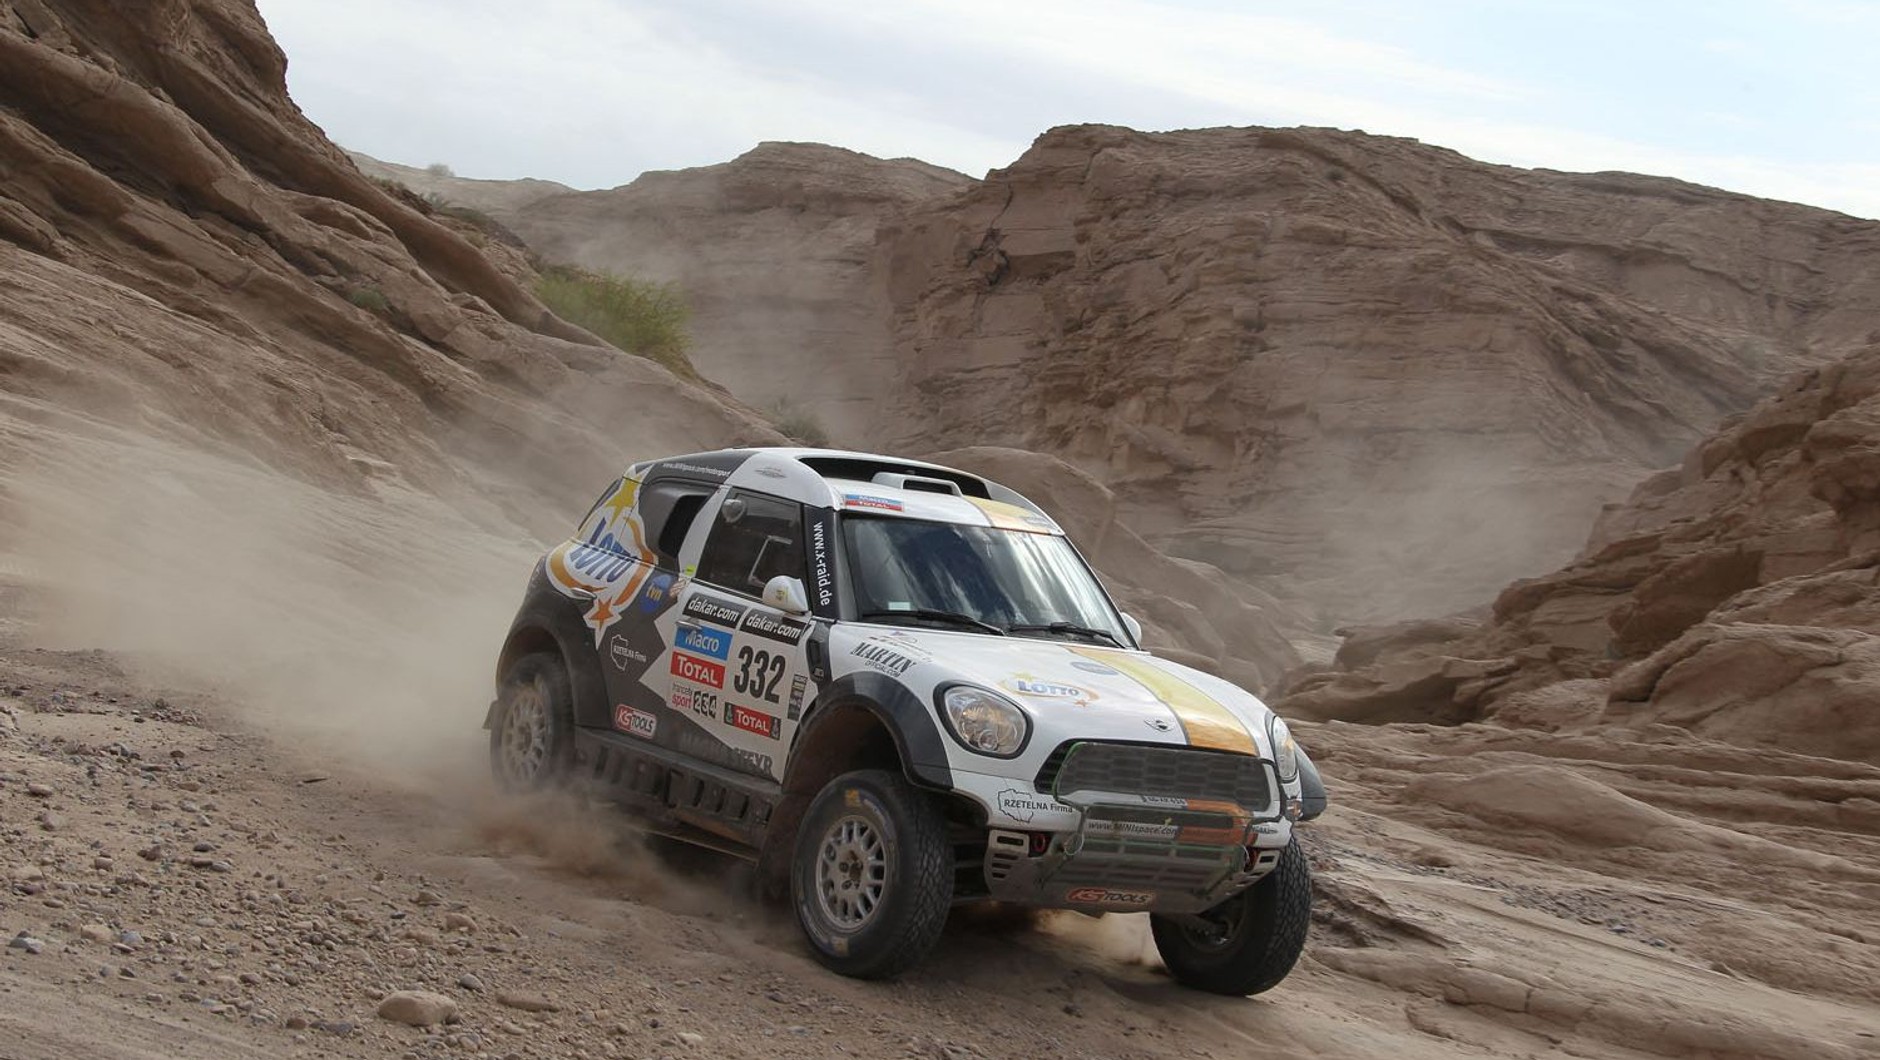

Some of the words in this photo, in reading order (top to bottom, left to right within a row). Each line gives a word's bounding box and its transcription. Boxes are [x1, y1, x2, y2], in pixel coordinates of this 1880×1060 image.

[813, 521, 833, 606] www.x-raid.de
[687, 597, 740, 622] dakar.com
[745, 614, 802, 639] dakar.com
[685, 630, 720, 652] Macro
[850, 642, 917, 673] MARTIN
[677, 657, 719, 685] TOTAL
[733, 645, 786, 704] 332
[1017, 680, 1080, 697] LOTTO
[735, 709, 770, 733] TOTAL
[1003, 799, 1049, 811] RZETELNA
[1050, 803, 1073, 813] Firma
